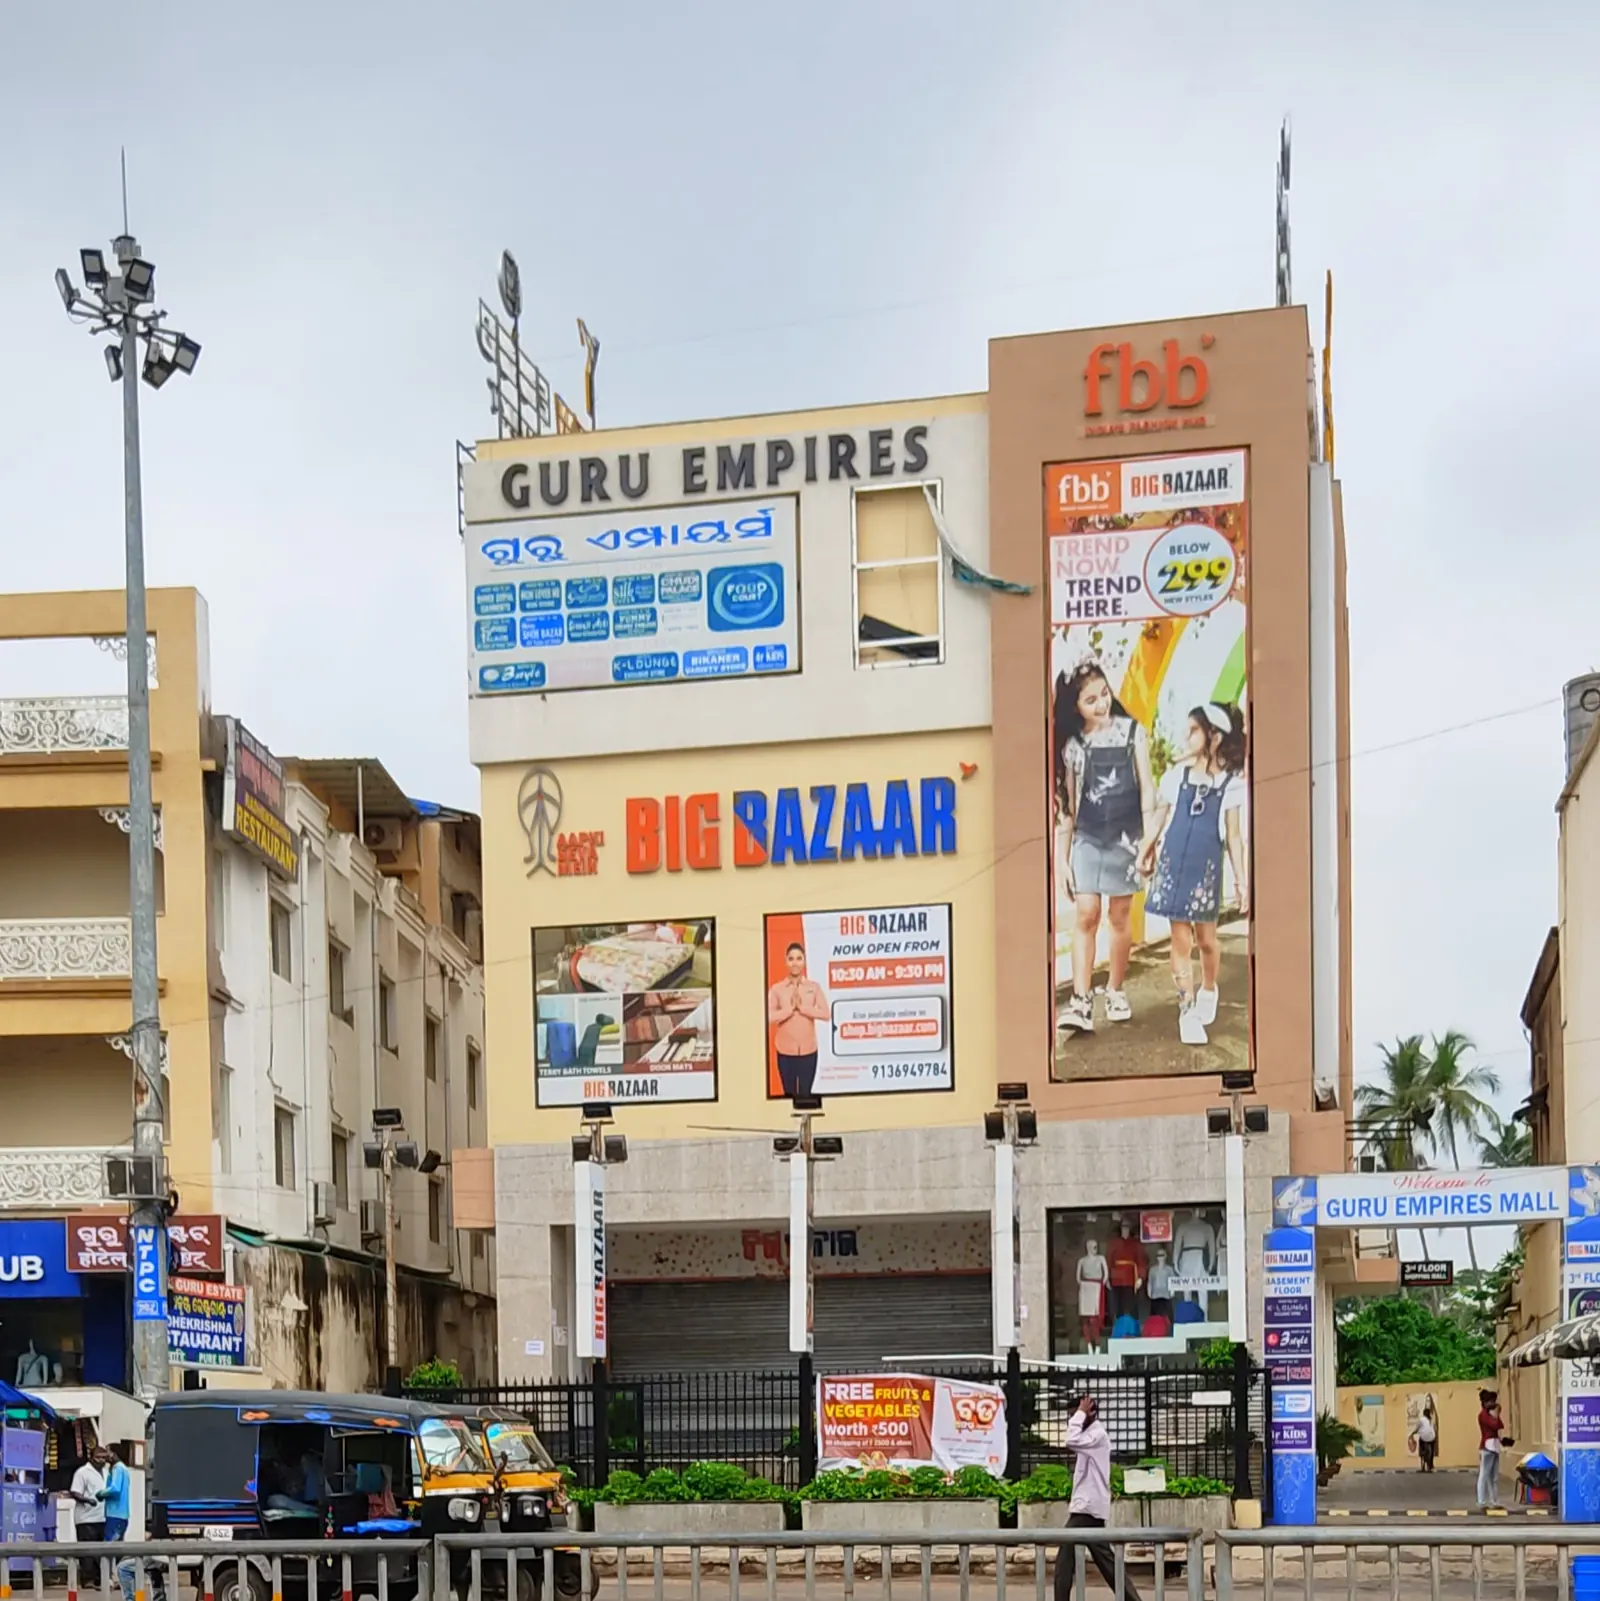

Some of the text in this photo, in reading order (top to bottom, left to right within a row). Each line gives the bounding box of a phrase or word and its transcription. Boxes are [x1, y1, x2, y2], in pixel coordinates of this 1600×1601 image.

[1083, 339, 1209, 416] fbb
[500, 425, 929, 508] GURU EMPIRES
[1058, 473, 1110, 504] fbb
[1131, 467, 1228, 498] BIG BAZAAR
[1054, 536, 1130, 557] TREND
[1169, 542, 1211, 556] BELOW
[1157, 556, 1233, 594] 299
[1066, 575, 1142, 598] TREND
[1066, 597, 1129, 619] HERE.
[625, 776, 957, 874] BIG BAZAAR
[236, 805, 298, 877] RESTAURANT
[840, 912, 928, 936] BIG BAZAAR
[833, 940, 941, 956] NOW OPEN FROM
[866, 966, 885, 980] AM
[539, 1066, 612, 1077] TERRY BATH TOWELS
[672, 1063, 693, 1071] MATS
[584, 1079, 659, 1098] BIG BAZAAR
[1393, 1172, 1493, 1190] Welcome to
[1325, 1191, 1560, 1217] GURU EMPIRES MALL
[594, 1190, 604, 1291] BAZAAR
[137, 1228, 156, 1293] NTPC
[1418, 1263, 1447, 1273] FLOOR
[175, 1278, 204, 1295] GURU
[206, 1282, 243, 1300] ESTATE
[825, 1383, 931, 1401] FREE FRUITS &
[825, 1403, 920, 1418] VEGETABLES
[825, 1421, 909, 1436] worth ₹500
[1283, 1429, 1307, 1440] KIDS
